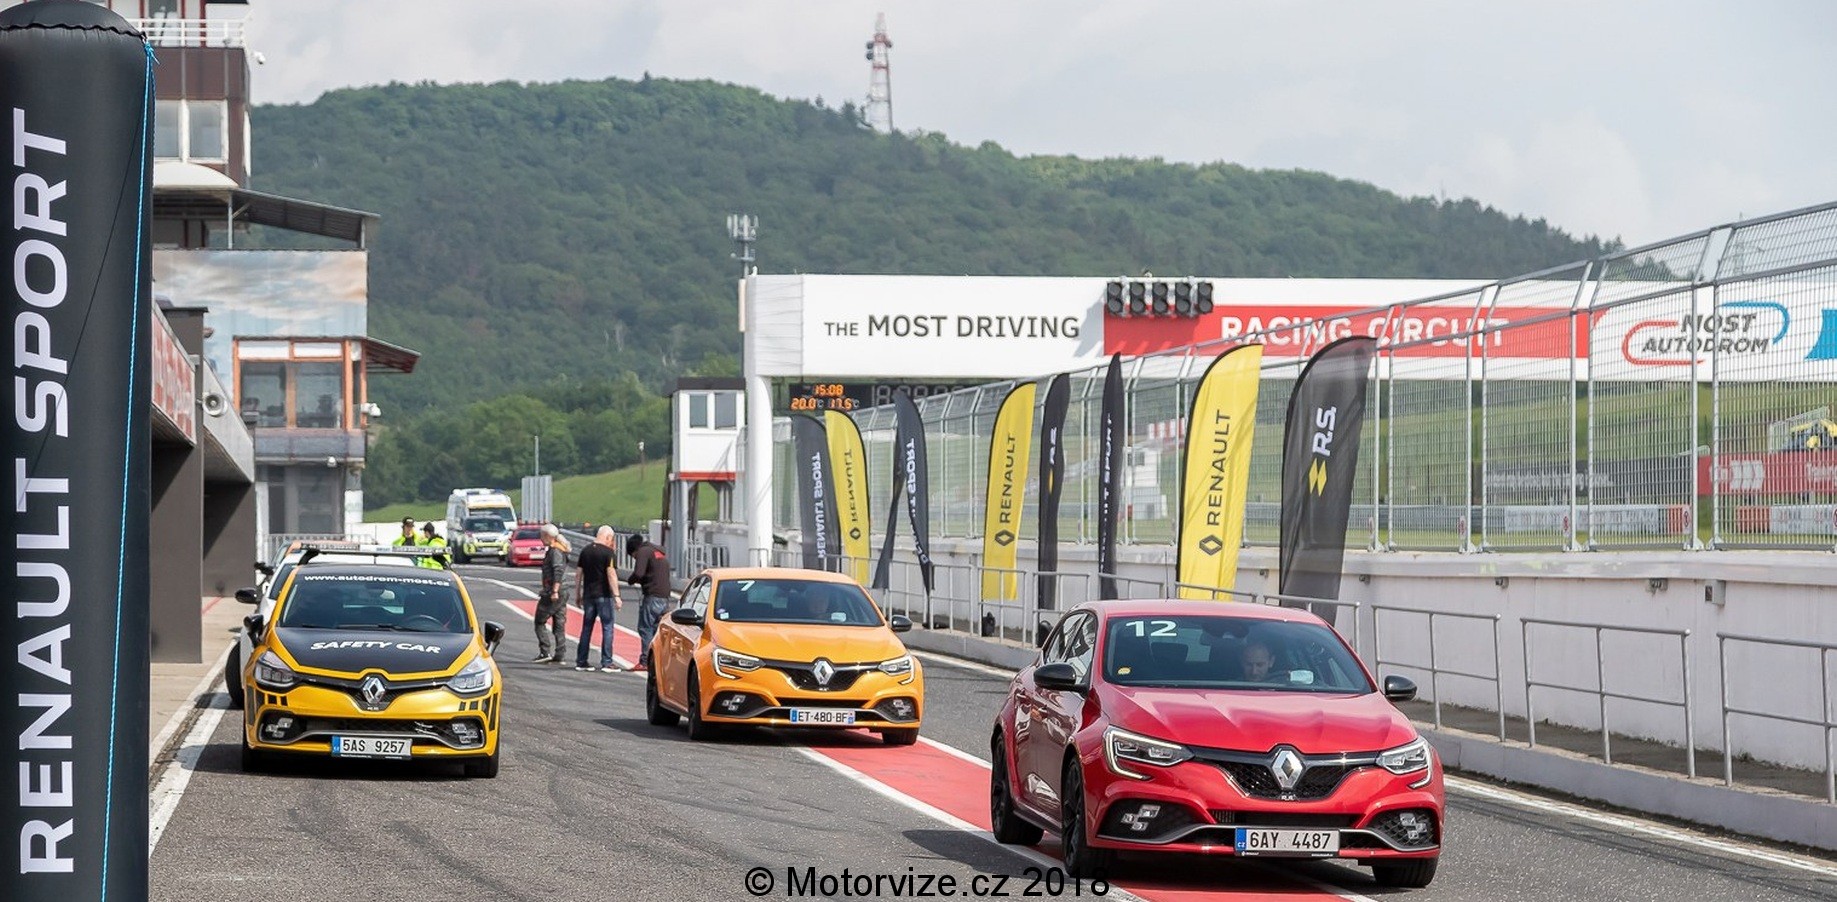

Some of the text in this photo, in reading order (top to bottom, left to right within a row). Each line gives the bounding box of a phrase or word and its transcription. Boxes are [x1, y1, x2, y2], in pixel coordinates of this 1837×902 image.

[824, 315, 1080, 339] THE MOST DRIVING
[1221, 316, 1510, 347] RACING CIRCUIT
[1681, 313, 1757, 334] MOST
[1642, 337, 1769, 354] AUTODROM
[814, 384, 844, 397] 15:08
[1311, 405, 1337, 457] R.S.
[1206, 409, 1231, 526] RENAULT
[1000, 434, 1016, 524] RENAULT
[13, 107, 75, 874] RENAULT SPORT
[304, 574, 450, 587] www.autodrom-most.cz
[737, 580, 756, 592] 7
[1126, 620, 1178, 638] 12
[310, 641, 442, 654] SAFETY CAR
[798, 711, 848, 723] ET-480-BF
[342, 739, 366, 752] 5AS
[374, 740, 406, 754] 9257
[1250, 831, 1332, 850] 6AY 4487
